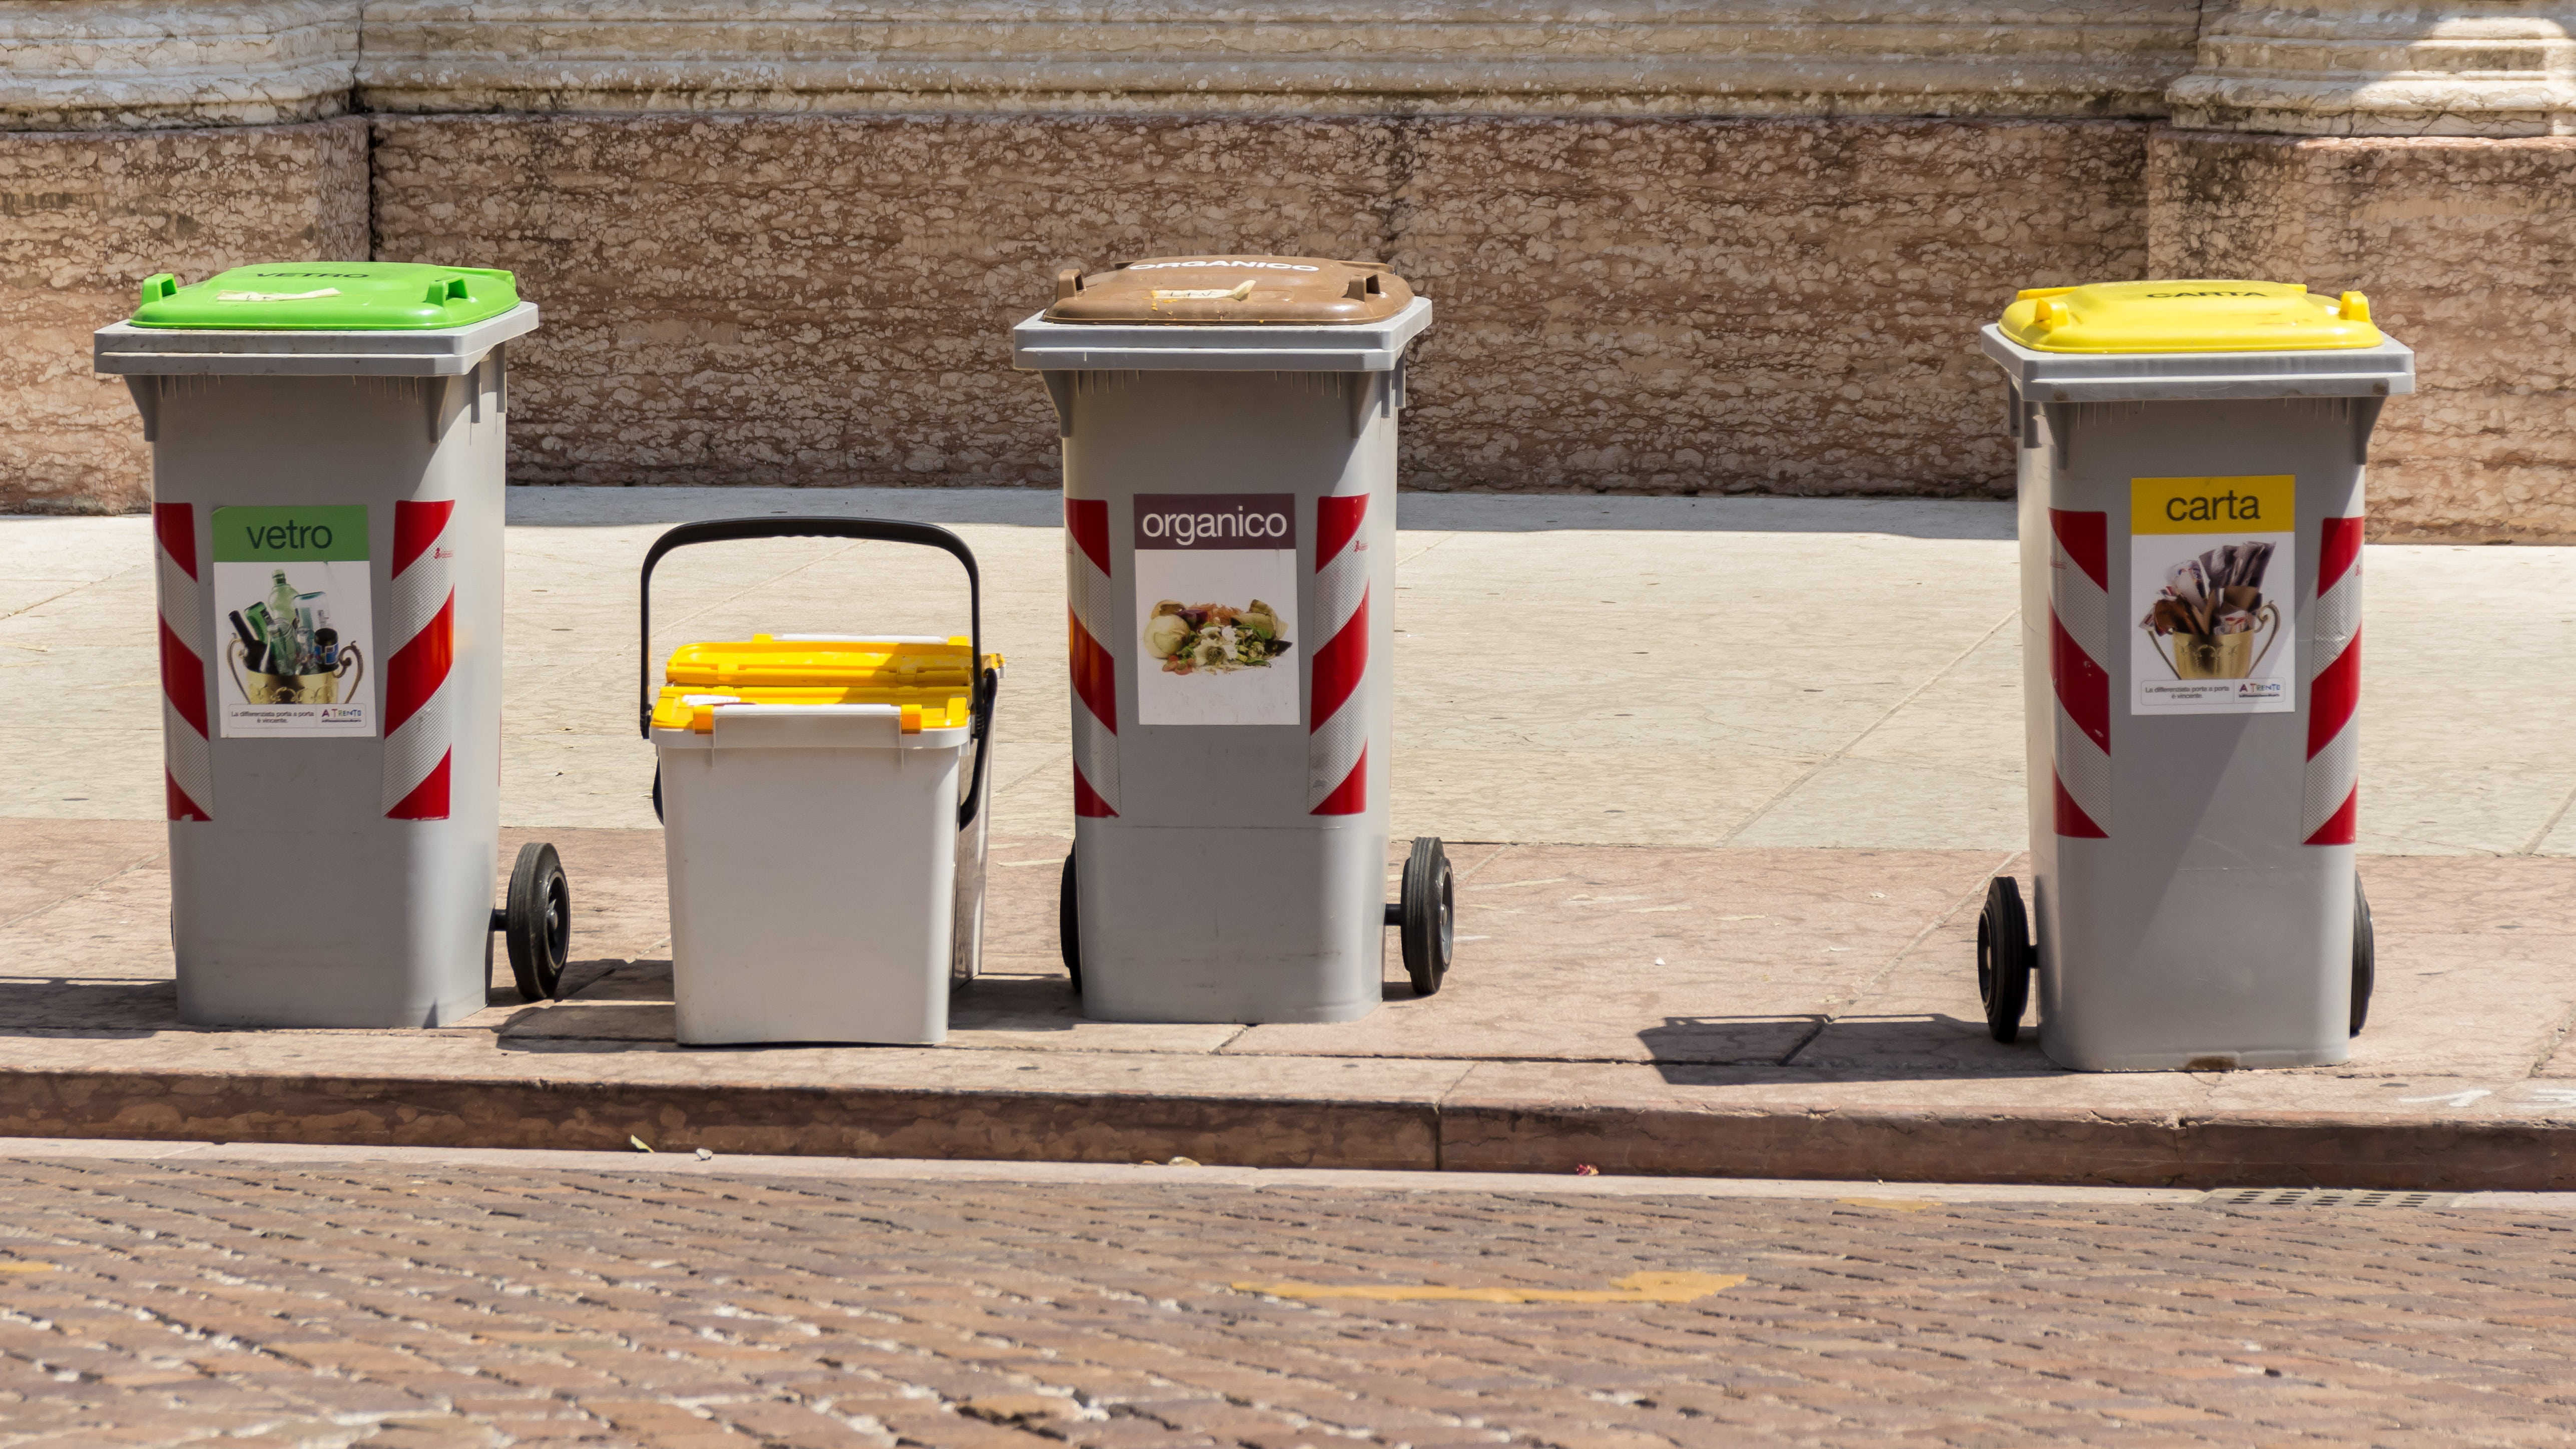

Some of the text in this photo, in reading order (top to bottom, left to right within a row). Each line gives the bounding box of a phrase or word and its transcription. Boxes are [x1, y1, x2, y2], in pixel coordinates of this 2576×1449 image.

[1129, 260, 1319, 272] ORGANICO
[2166, 490, 2261, 522] carta
[246, 520, 332, 550] vetro
[1143, 506, 1287, 546] organico
[2240, 684, 2248, 692] A
